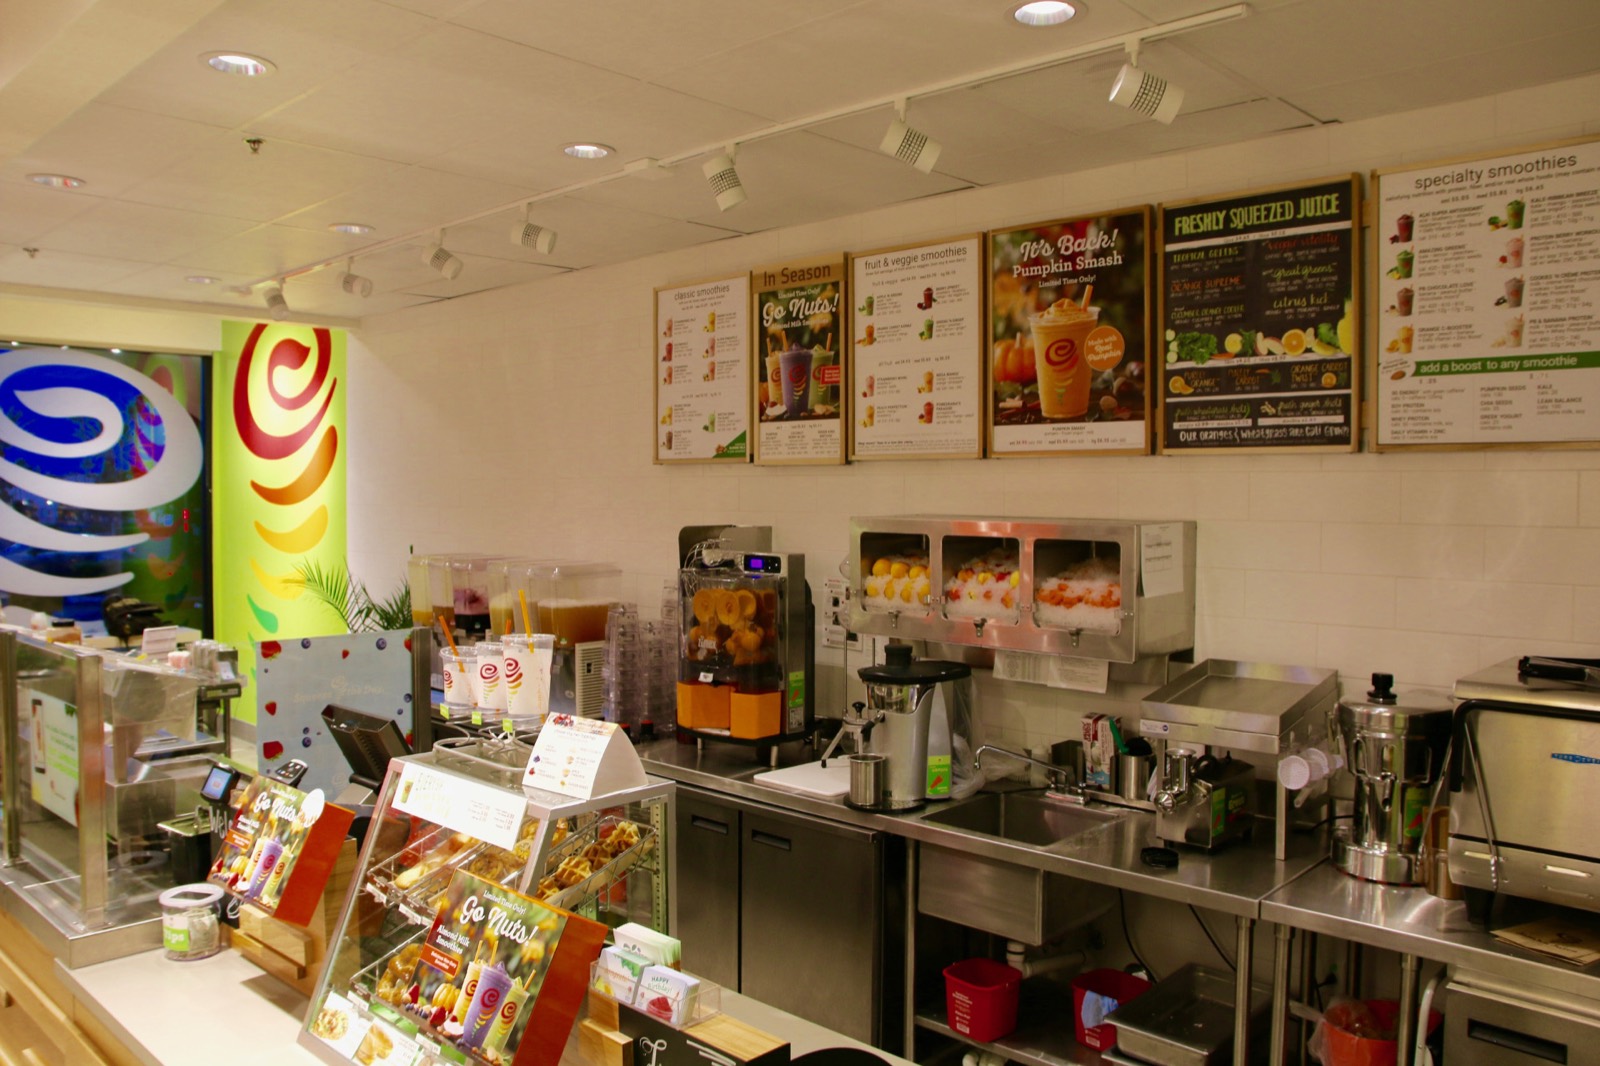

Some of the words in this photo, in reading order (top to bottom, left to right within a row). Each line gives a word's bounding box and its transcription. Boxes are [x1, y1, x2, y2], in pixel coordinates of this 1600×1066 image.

[1414, 169, 1483, 190] specialty
[1488, 154, 1577, 178] smoothies
[1174, 209, 1226, 236] FRESHLY
[1230, 200, 1294, 230] SQUEEZED
[1296, 192, 1340, 218] JUICE
[1020, 238, 1054, 262] It's
[1058, 228, 1119, 256] Back!
[864, 259, 881, 270] fruit
[883, 257, 889, 268] &
[890, 253, 919, 266] veggie
[920, 246, 968, 262] smoothies
[1012, 258, 1072, 278] Pumpkin
[1076, 250, 1123, 270] Smash
[764, 271, 776, 286] In
[781, 264, 831, 284] Season
[1038, 278, 1062, 288] Limited
[1062, 277, 1078, 286] Time
[1078, 274, 1096, 284] Only!
[674, 290, 696, 300] classic
[696, 284, 730, 296] smoothies
[763, 302, 786, 327] Go
[789, 293, 839, 319] Nuts!
[1087, 349, 1121, 362] Pumpkin
[1420, 362, 1440, 373] add
[1451, 361, 1482, 372] boost
[1486, 360, 1498, 370] to
[1500, 360, 1520, 371] any
[1522, 355, 1578, 368] smoothie
[253, 791, 271, 813] Go
[483, 890, 501, 904] Limited
[501, 897, 513, 909] Time
[513, 903, 527, 916] Only!
[460, 895, 486, 924] Go
[488, 906, 539, 947] Nuts!
[436, 934, 463, 955] Smoothies
[652, 976, 669, 984] HAPPY
